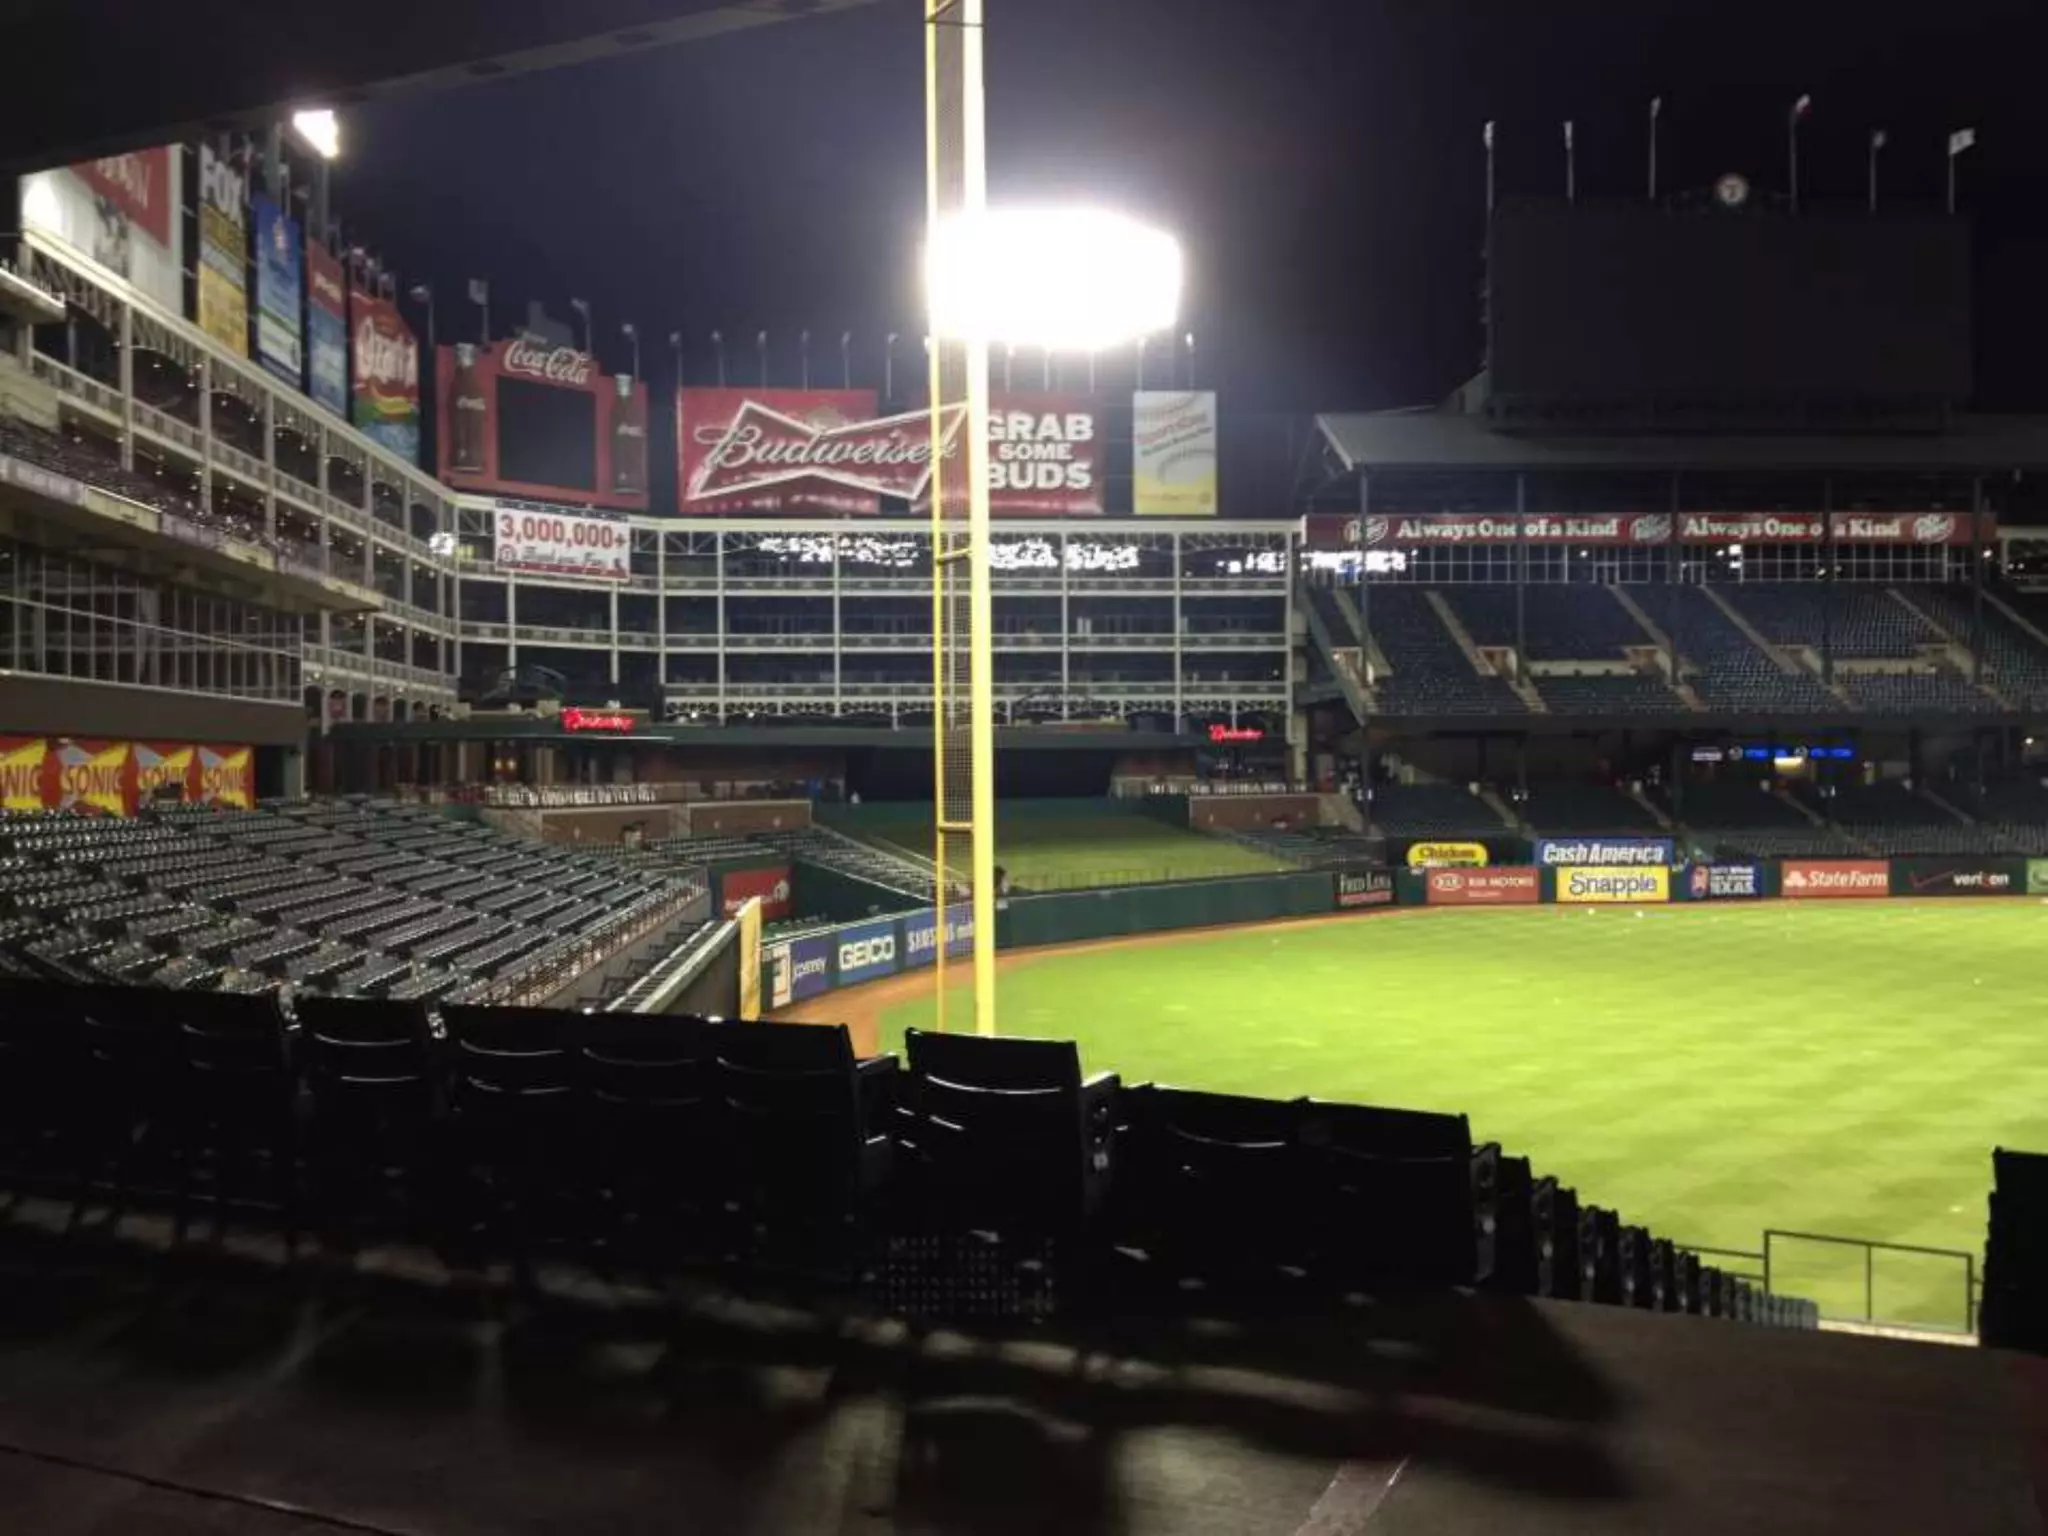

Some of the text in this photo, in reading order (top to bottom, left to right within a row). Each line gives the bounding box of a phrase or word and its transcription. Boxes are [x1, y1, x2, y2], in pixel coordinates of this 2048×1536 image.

[988, 412, 1094, 441] GRAB
[693, 424, 957, 472] Budweiser
[999, 443, 1073, 461] SOME
[988, 461, 1092, 489] BUDS
[500, 514, 627, 550] 3,000,000+
[1397, 519, 1477, 541] Always
[1565, 518, 1618, 537] Kind
[1683, 516, 1762, 540] Always
[1764, 517, 1806, 537] One
[1848, 517, 1900, 537] Kind
[0, 763, 42, 796] NIC
[58, 764, 124, 795] SONIC
[1569, 872, 1657, 898] Snapple
[1953, 870, 2010, 888] verizon
[839, 934, 895, 971] GEICO
